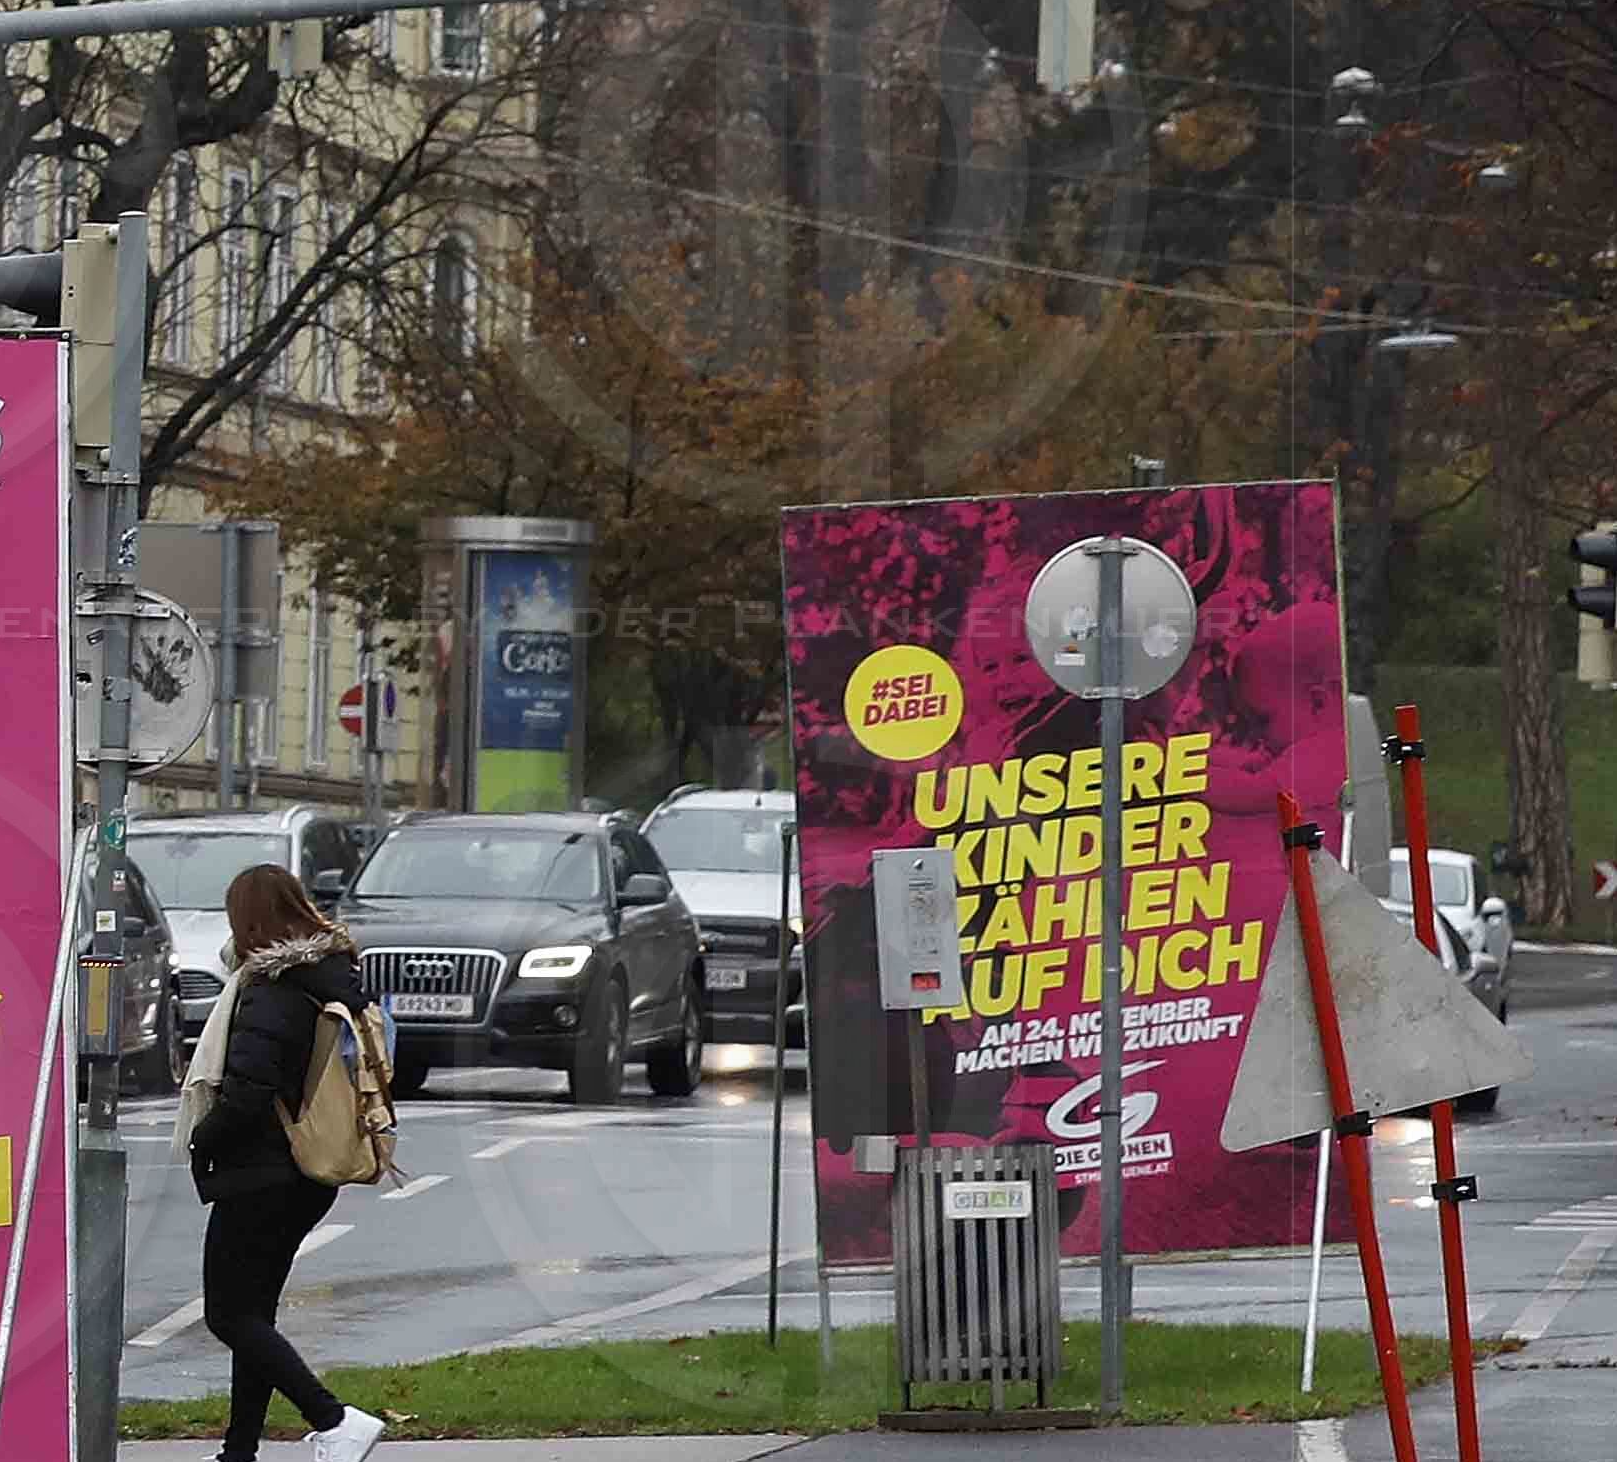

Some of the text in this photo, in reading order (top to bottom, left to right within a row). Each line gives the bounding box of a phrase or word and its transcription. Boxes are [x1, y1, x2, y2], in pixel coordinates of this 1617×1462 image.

[862, 693, 949, 728] DABEI
[871, 672, 935, 700] #SEI
[913, 731, 1212, 830] UNSERE
[935, 799, 1212, 890] KINDER
[954, 1014, 1245, 1075] MACHEN WI ZUKUNFT
[979, 995, 1212, 1049] AM 24. NOEMBER
